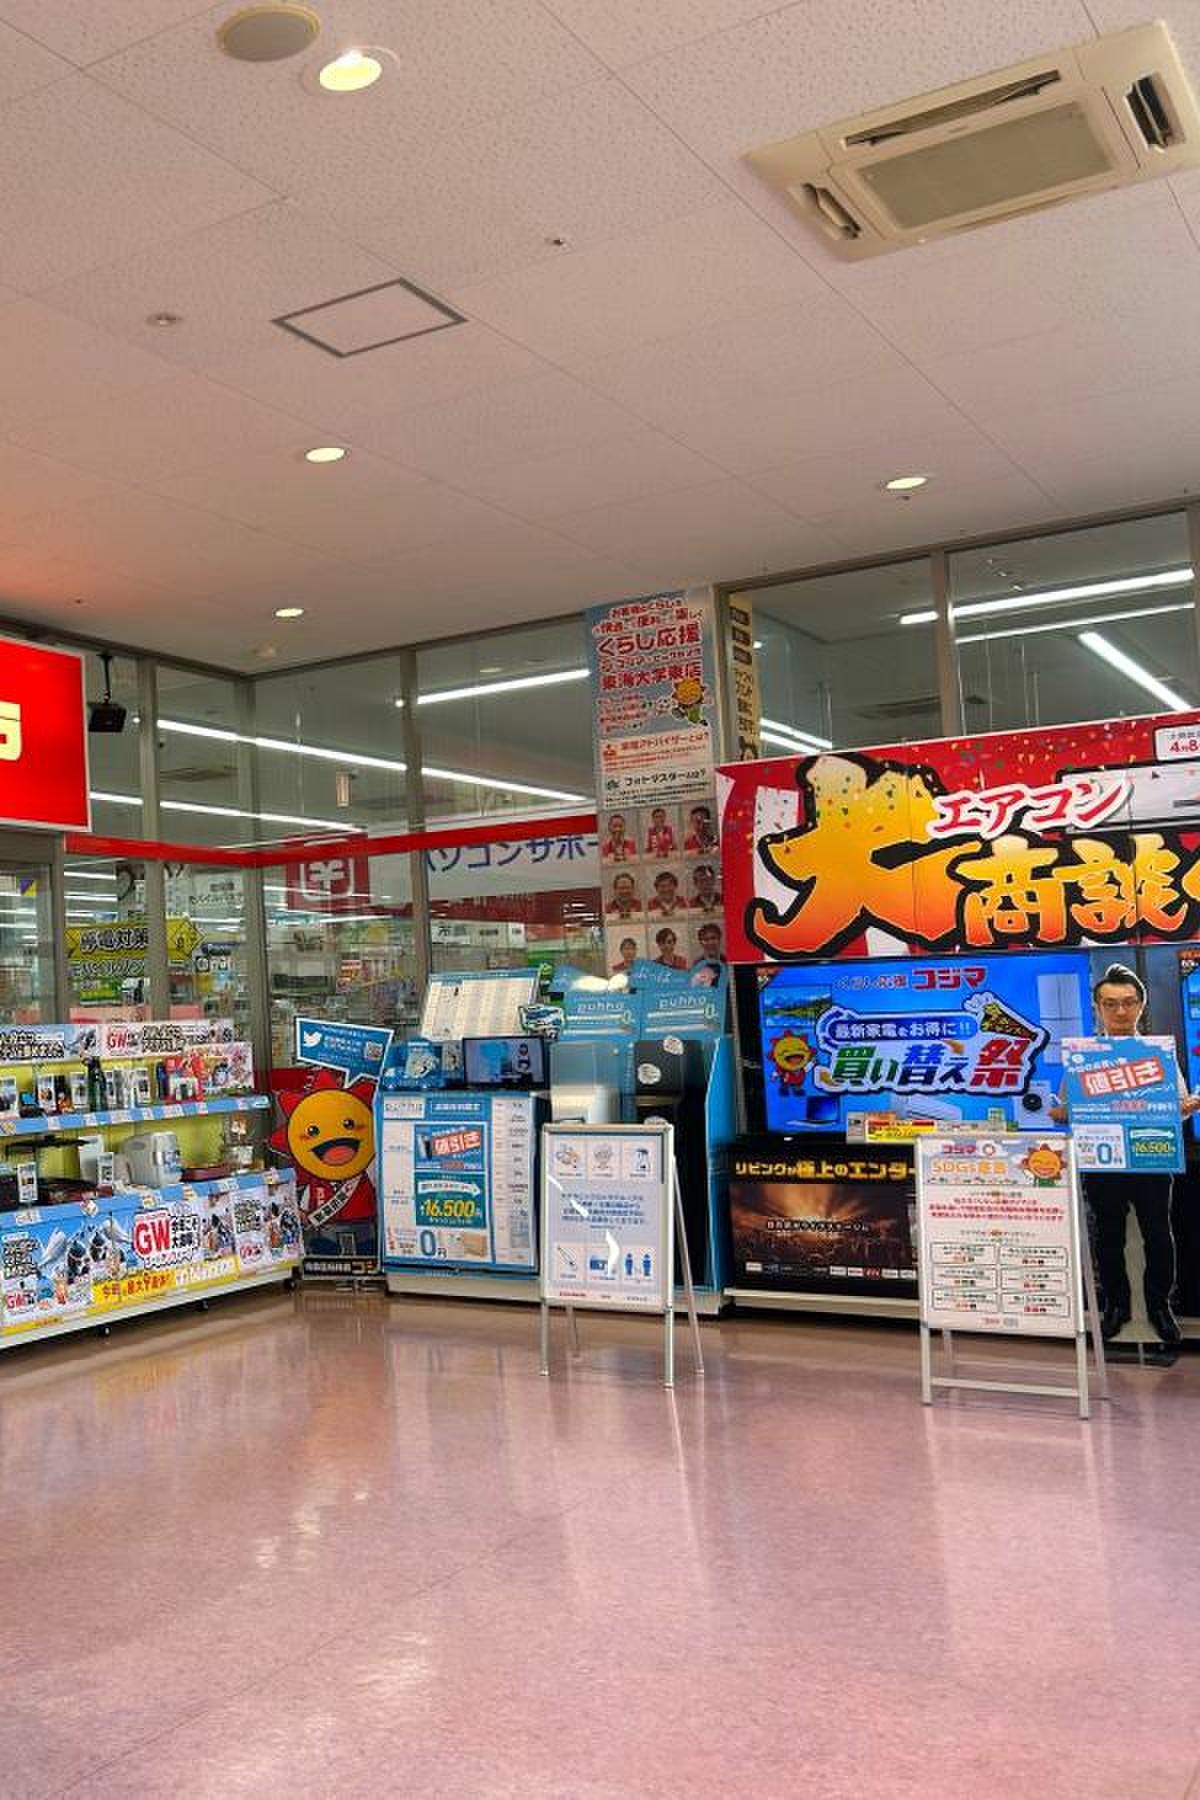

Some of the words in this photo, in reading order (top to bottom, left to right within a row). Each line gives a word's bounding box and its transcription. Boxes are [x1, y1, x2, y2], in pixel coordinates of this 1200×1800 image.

[598, 622, 701, 657] くらし応援
[933, 778, 1125, 835] エアコン
[911, 966, 987, 991] コジマ
[831, 1038, 1033, 1087] 買い替え祭
[1084, 1058, 1161, 1096] 値引き
[425, 1199, 477, 1217] 16,500
[134, 1217, 171, 1255] GW
